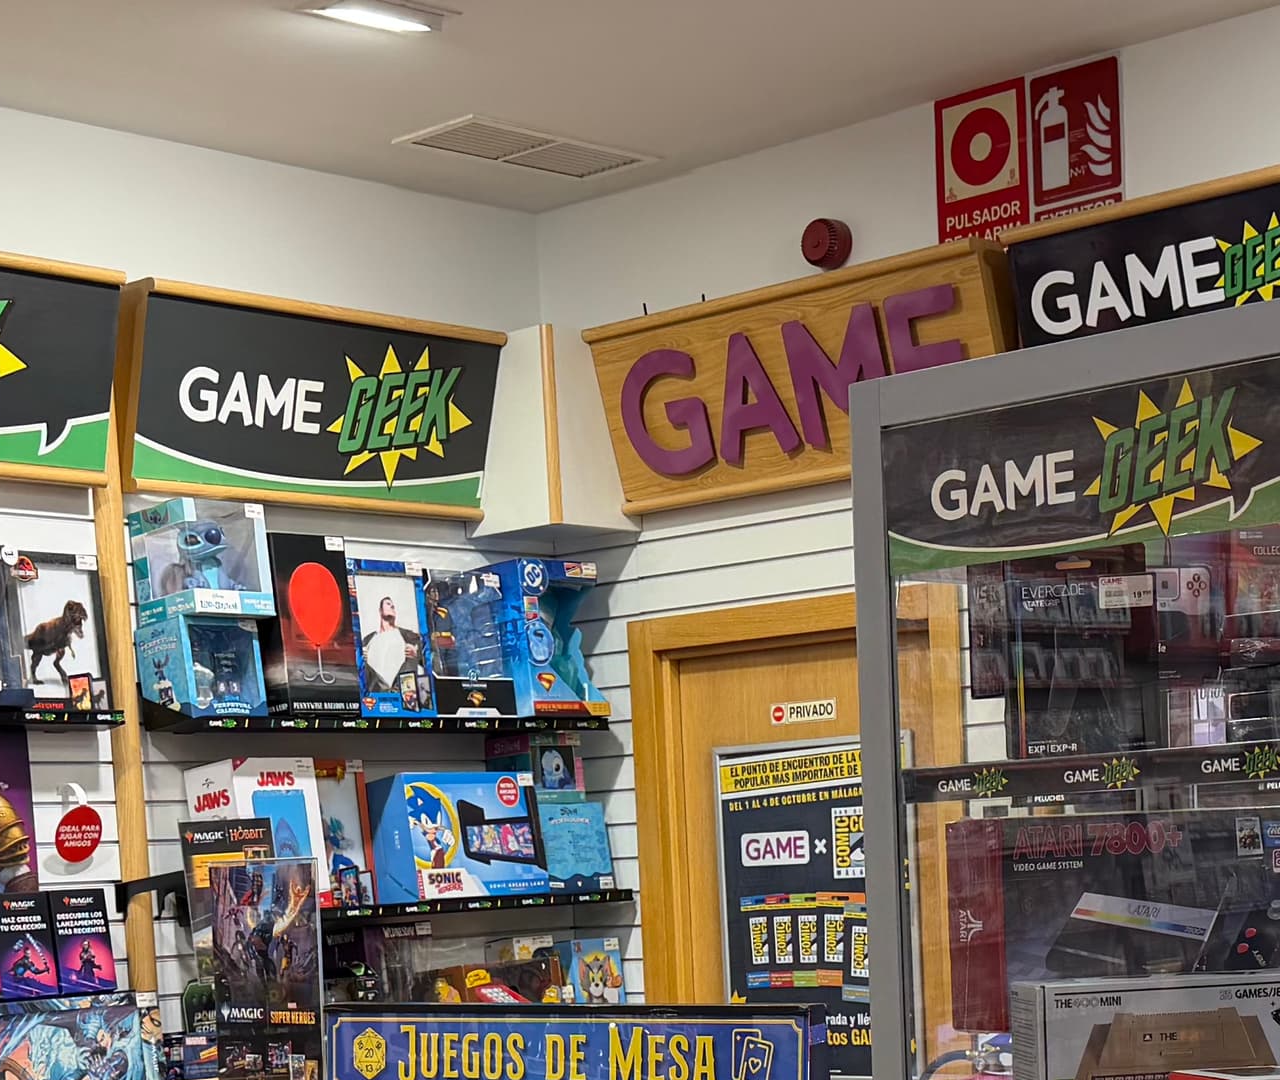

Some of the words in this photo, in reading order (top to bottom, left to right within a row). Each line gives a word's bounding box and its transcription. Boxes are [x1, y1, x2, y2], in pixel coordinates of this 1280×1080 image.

[946, 201, 1021, 232] PULSADOR
[1031, 235, 1225, 335] GAME
[179, 366, 324, 434] GAME
[338, 367, 461, 454] GEEK
[931, 450, 1075, 521] GAME
[1099, 387, 1236, 513] GEEK
[789, 702, 833, 720] PRIVADO
[730, 768, 738, 777] EL
[741, 764, 767, 776] PUNTO
[770, 762, 780, 772] DE
[782, 755, 830, 770] ENCUENTRO
[833, 754, 843, 763] DE
[846, 752, 856, 761] LA
[734, 776, 770, 789] POPULAR
[792, 767, 845, 782] IMPORTANTE
[848, 764, 858, 775] DE
[1201, 759, 1240, 773] GAME
[258, 770, 295, 786] JAWS
[938, 778, 971, 791] GAME
[1064, 770, 1099, 784] GAME
[729, 802, 742, 812] DEL
[746, 801, 748, 809] 1
[752, 800, 760, 808] AL
[762, 798, 767, 807] 4
[770, 798, 779, 806] DE
[782, 792, 816, 804] OCTUBRE
[819, 792, 829, 800] EN
[746, 836, 806, 860] GAME
[1014, 824, 1083, 860] ATARI
[1014, 863, 1035, 871] VIDEO
[1036, 862, 1056, 870] GAME
[1058, 860, 1083, 869] SYSTEM
